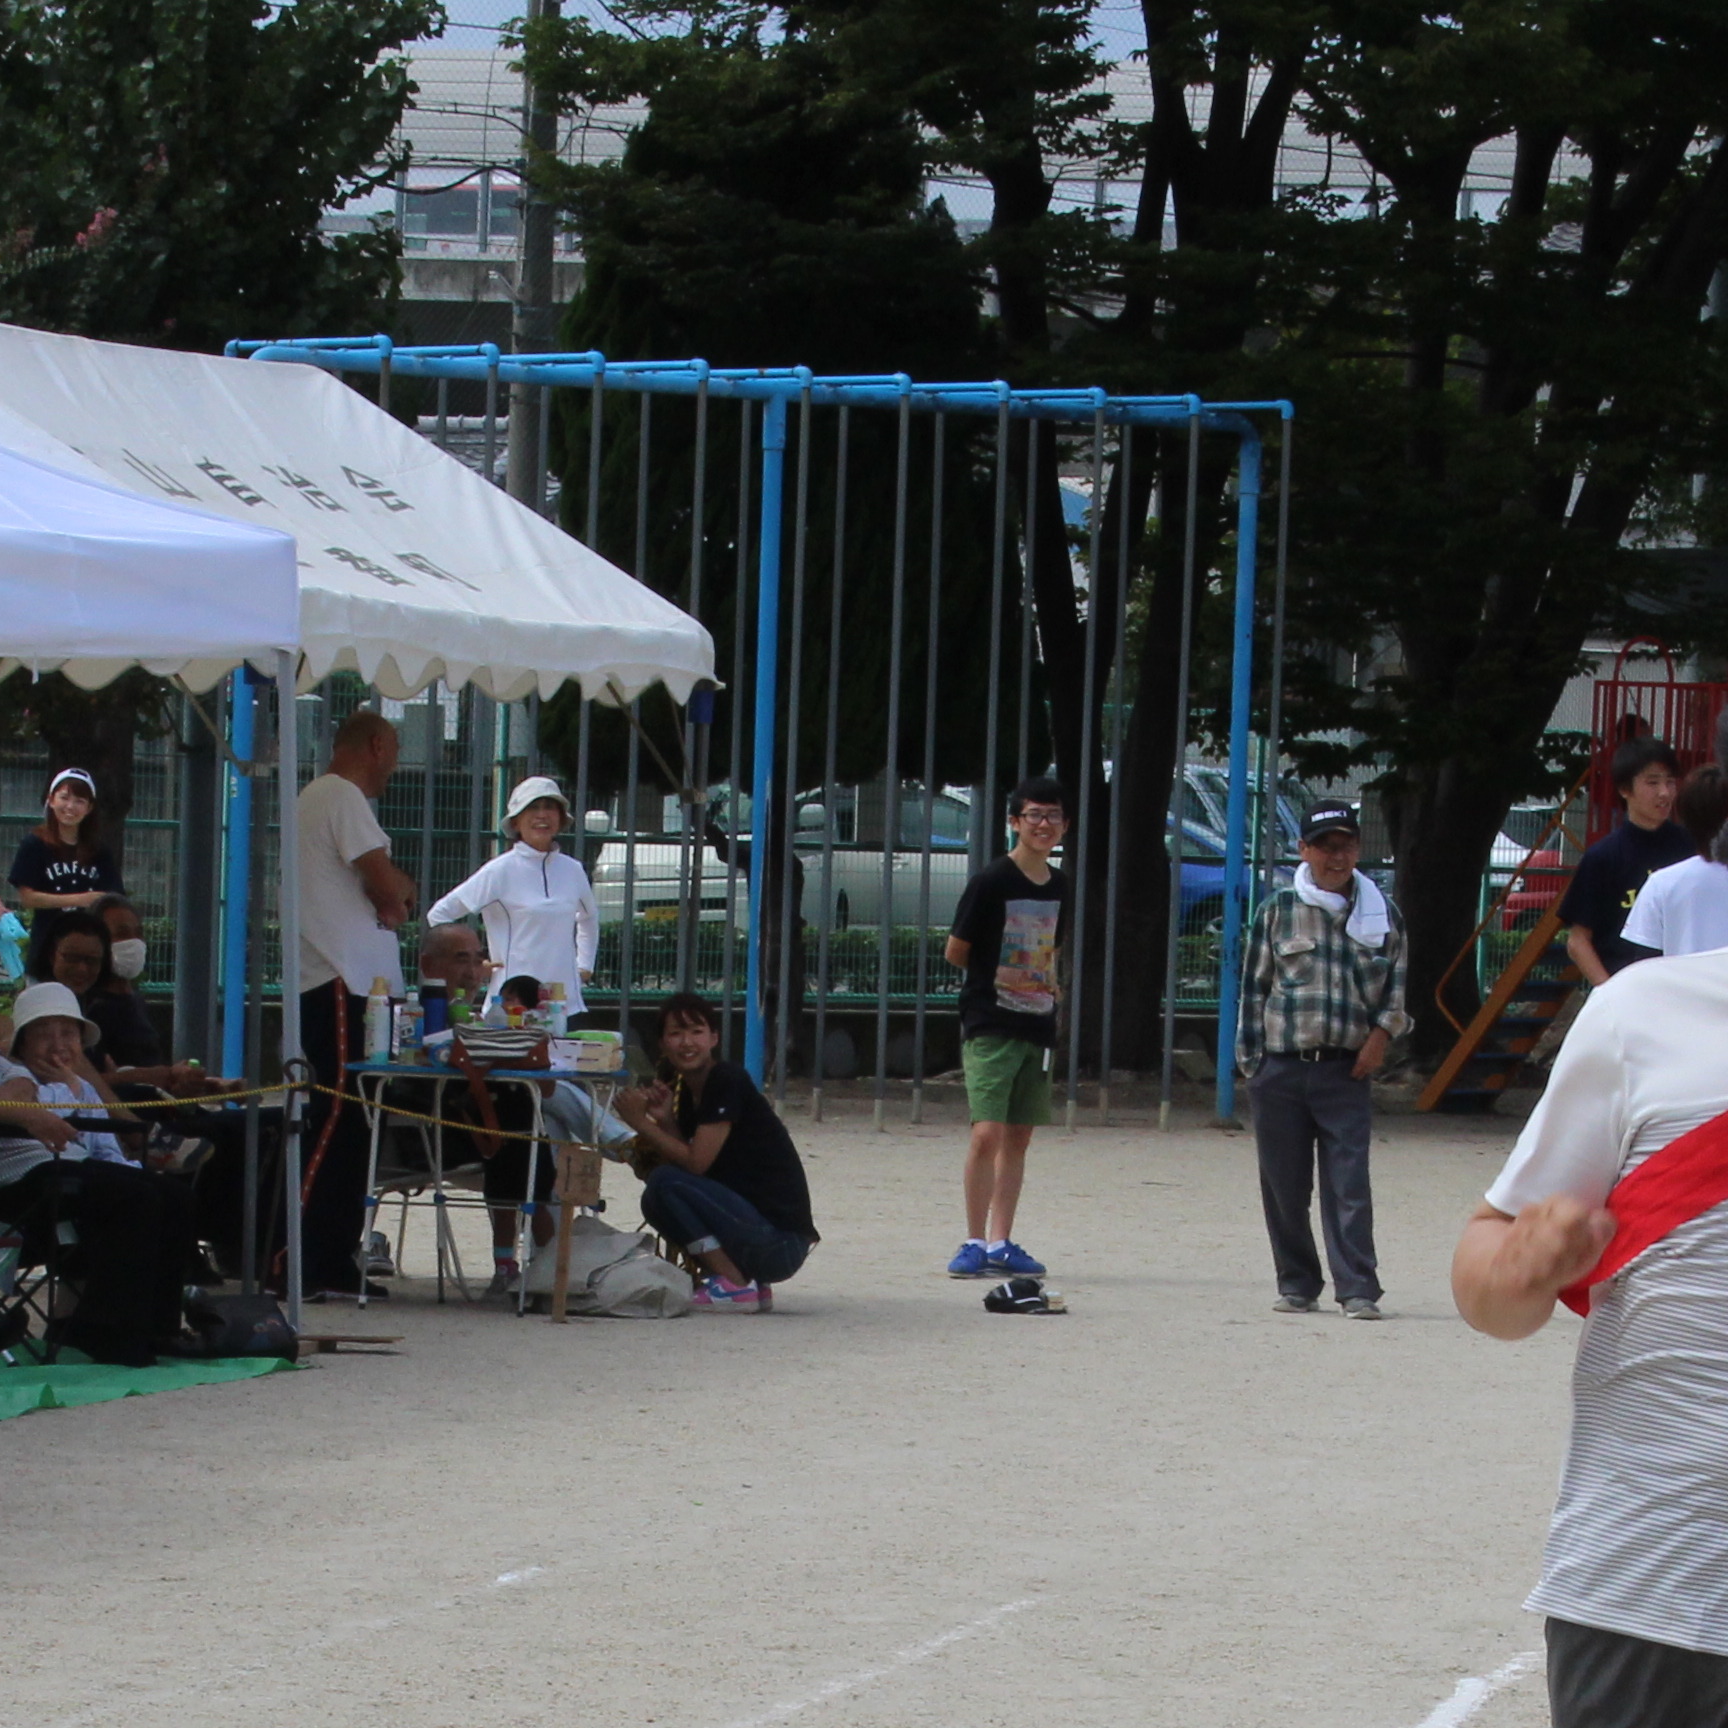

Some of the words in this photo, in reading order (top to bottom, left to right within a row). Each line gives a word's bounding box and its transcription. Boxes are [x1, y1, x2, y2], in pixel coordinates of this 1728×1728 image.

[70, 445, 416, 512] 山自治会
[297, 546, 483, 592] 番町
